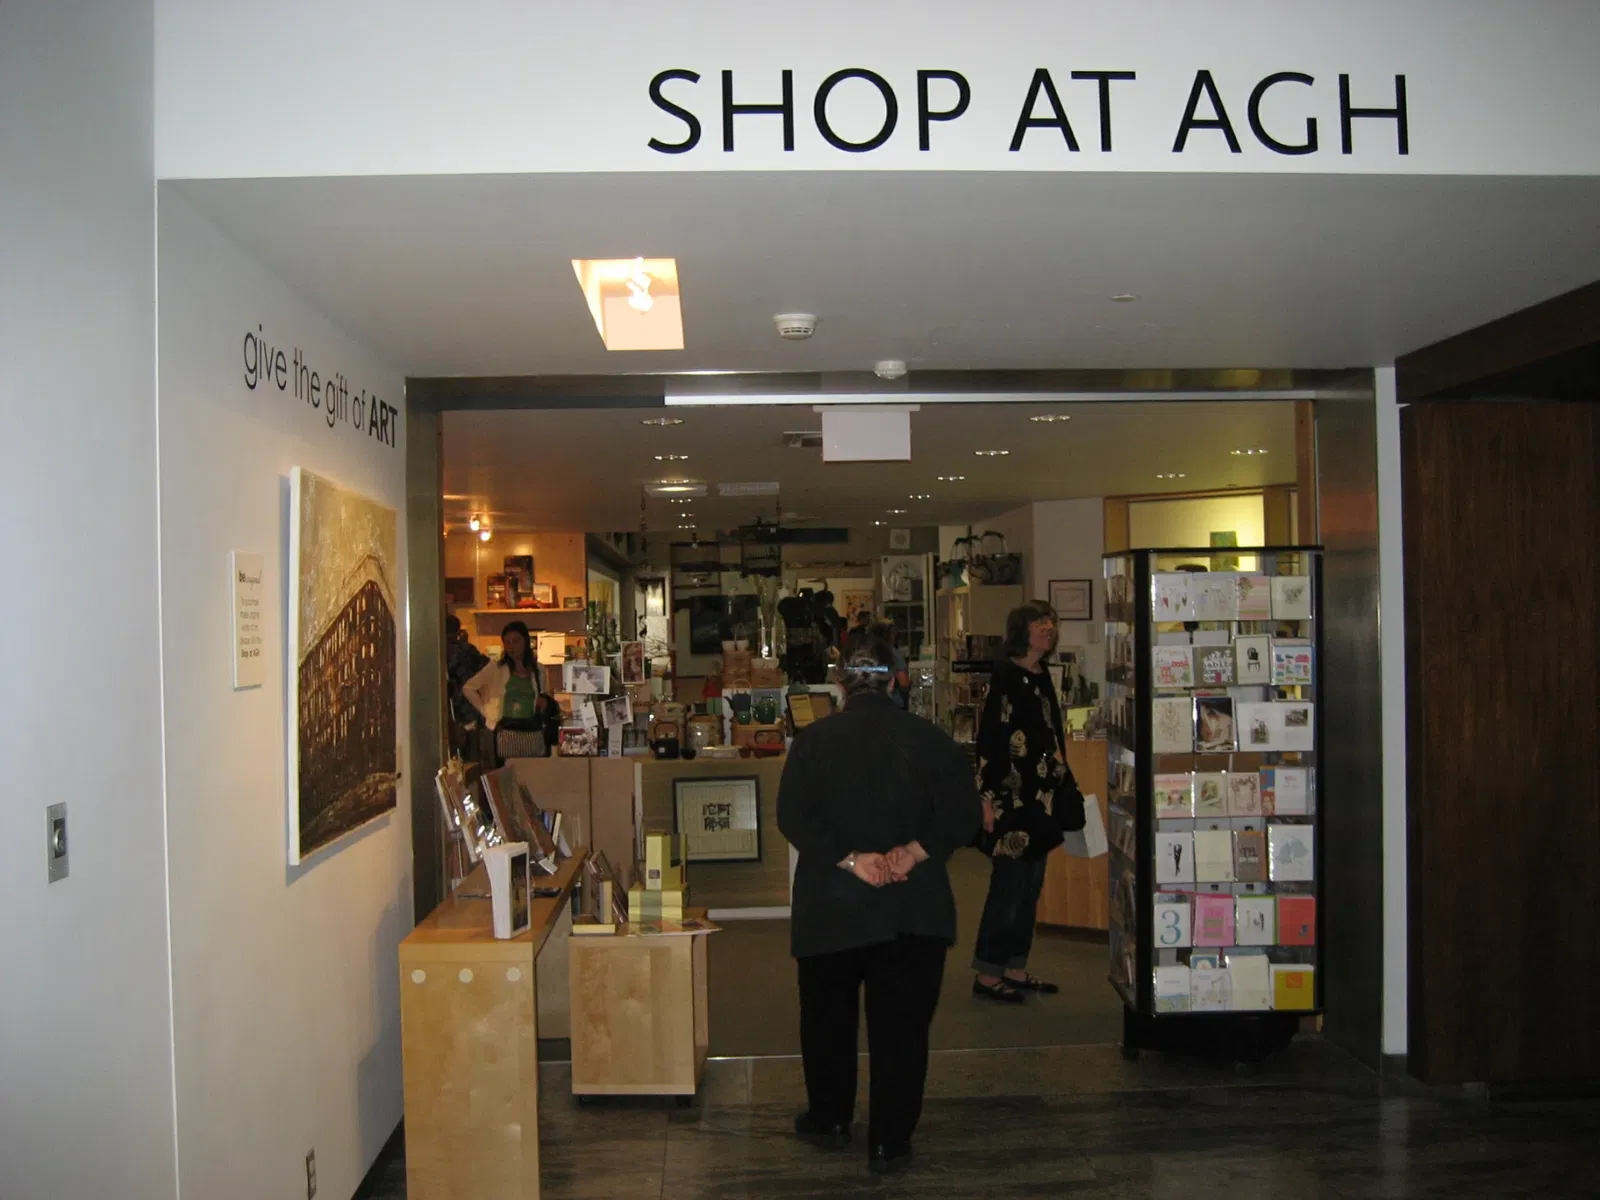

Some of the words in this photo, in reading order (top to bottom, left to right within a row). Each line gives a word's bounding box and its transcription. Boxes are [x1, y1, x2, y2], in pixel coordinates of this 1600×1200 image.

[646, 68, 971, 154] SHOP
[1008, 67, 1135, 152] AT
[1172, 69, 1409, 155] AGH
[244, 324, 287, 390] give
[293, 347, 320, 408] the
[325, 373, 348, 428] gift
[352, 389, 366, 431] of
[368, 395, 398, 448] ART
[1160, 909, 1182, 945] 3
